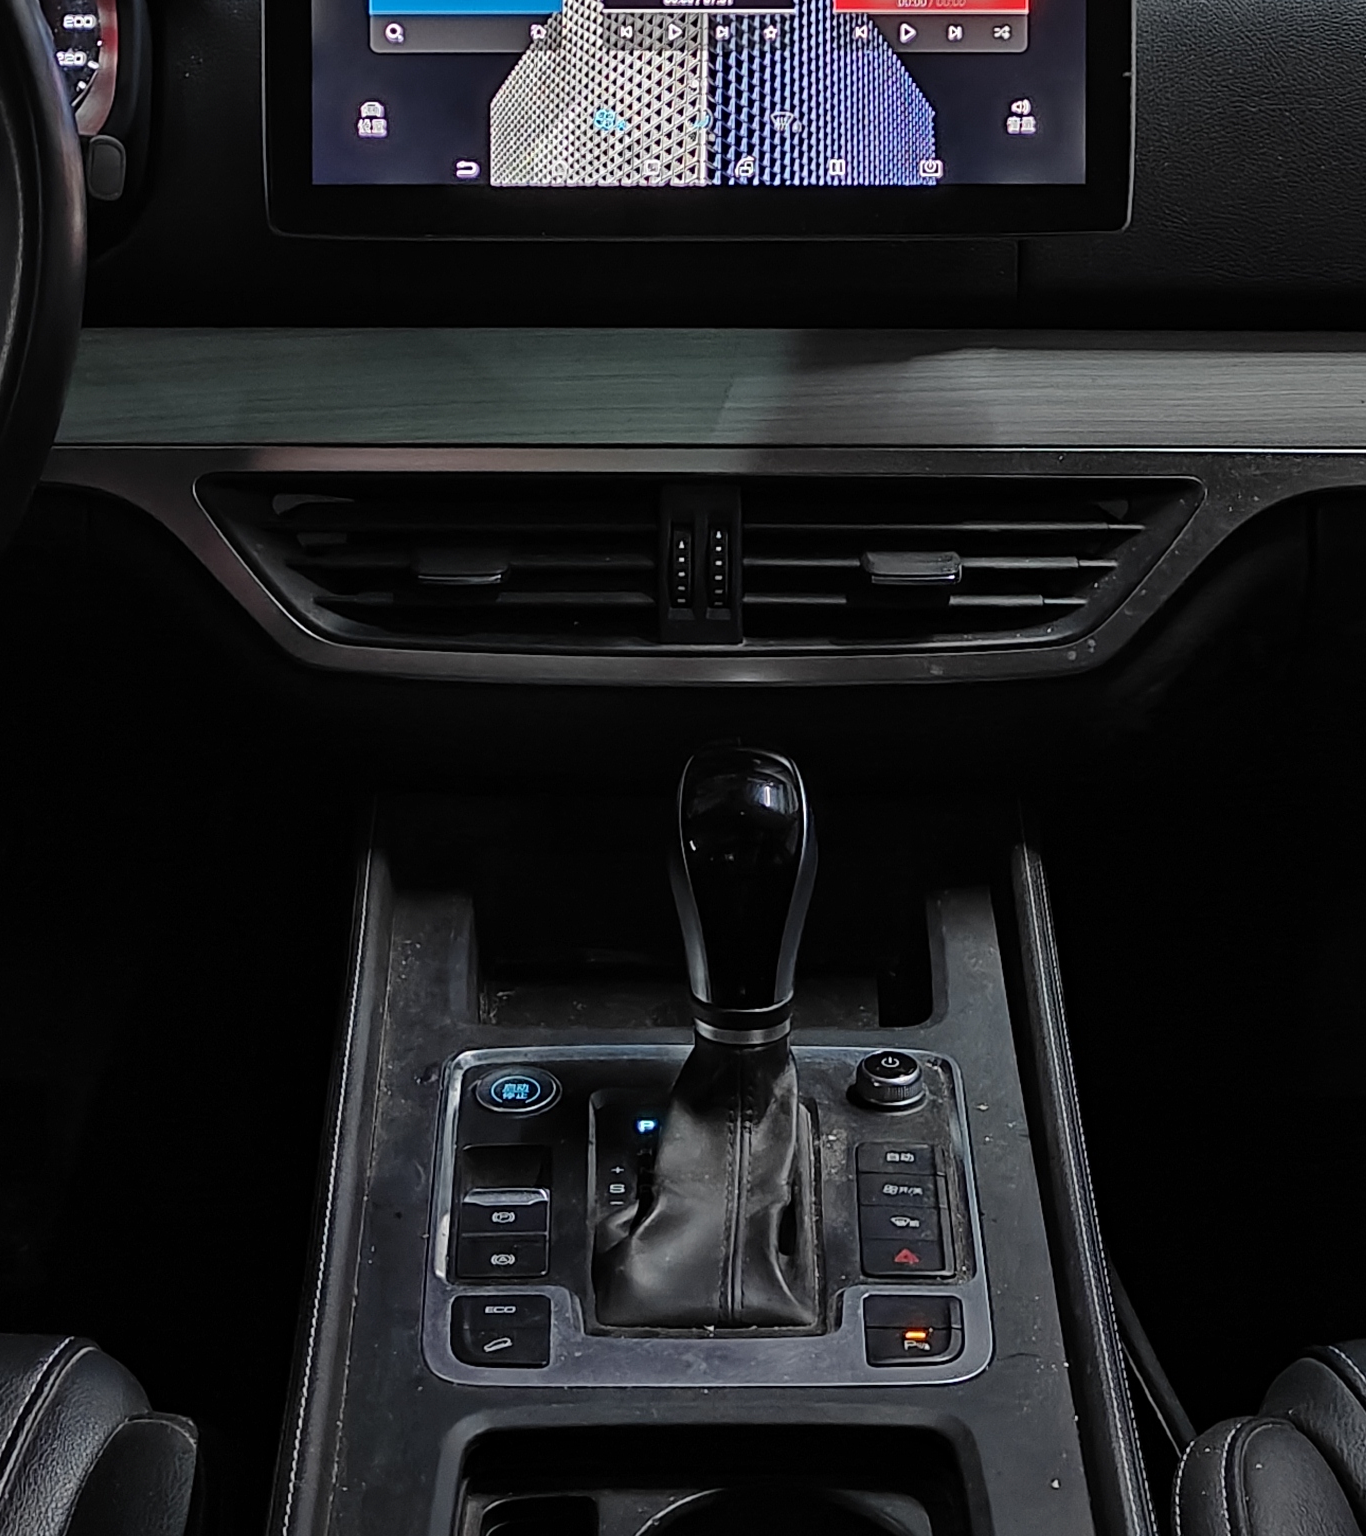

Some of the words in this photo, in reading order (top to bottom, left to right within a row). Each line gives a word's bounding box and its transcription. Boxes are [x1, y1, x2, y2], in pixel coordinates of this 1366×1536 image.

[63, 14, 97, 30] 200
[637, 1119, 655, 1132] P
[609, 1183, 625, 1194] S
[485, 1306, 516, 1314] ECO
